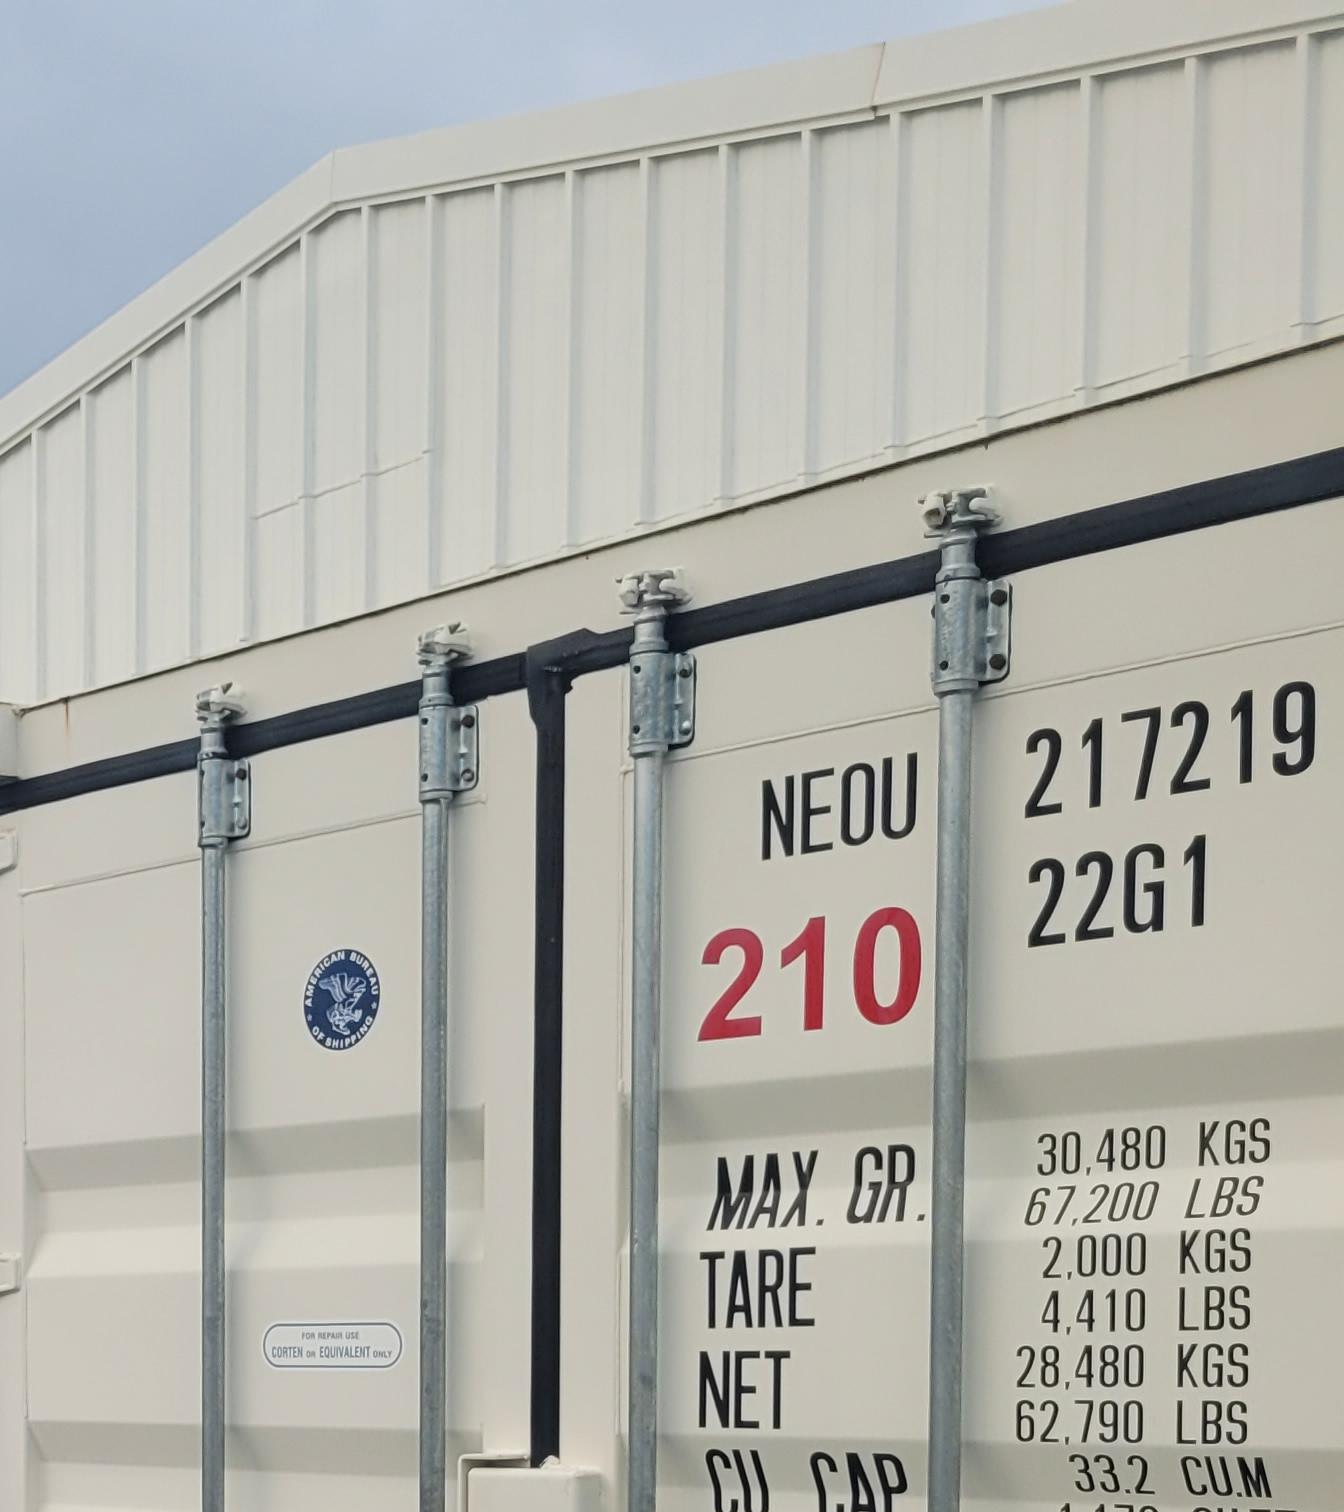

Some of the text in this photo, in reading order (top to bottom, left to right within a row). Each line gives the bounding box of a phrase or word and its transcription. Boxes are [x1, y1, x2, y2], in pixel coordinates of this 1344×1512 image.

[761, 681, 1316, 860] NEOU 217219
[1028, 834, 1207, 947] 22G1
[305, 951, 379, 1007] AMERICAN BUREAU
[696, 906, 922, 1041] 210
[312, 1015, 373, 1048] OF SHIPPING
[1036, 1118, 1272, 1176] 30,480 KGS
[706, 1144, 926, 1231] MAX. GR.
[1023, 1175, 1265, 1227] 67,200 LBS
[1041, 1227, 1252, 1281] 2,000 KGS
[699, 1246, 816, 1329] TARE
[1040, 1284, 1251, 1335] 4,410 LBS
[272, 1346, 303, 1359] CORTEN
[319, 1346, 370, 1359] EQUIVALENT
[1015, 1343, 1250, 1391] 28,480 KGS
[698, 1350, 791, 1429] NET
[1015, 1399, 1249, 1446] 62,790 LBS
[1067, 1454, 1273, 1500] 33.2 CU.M
